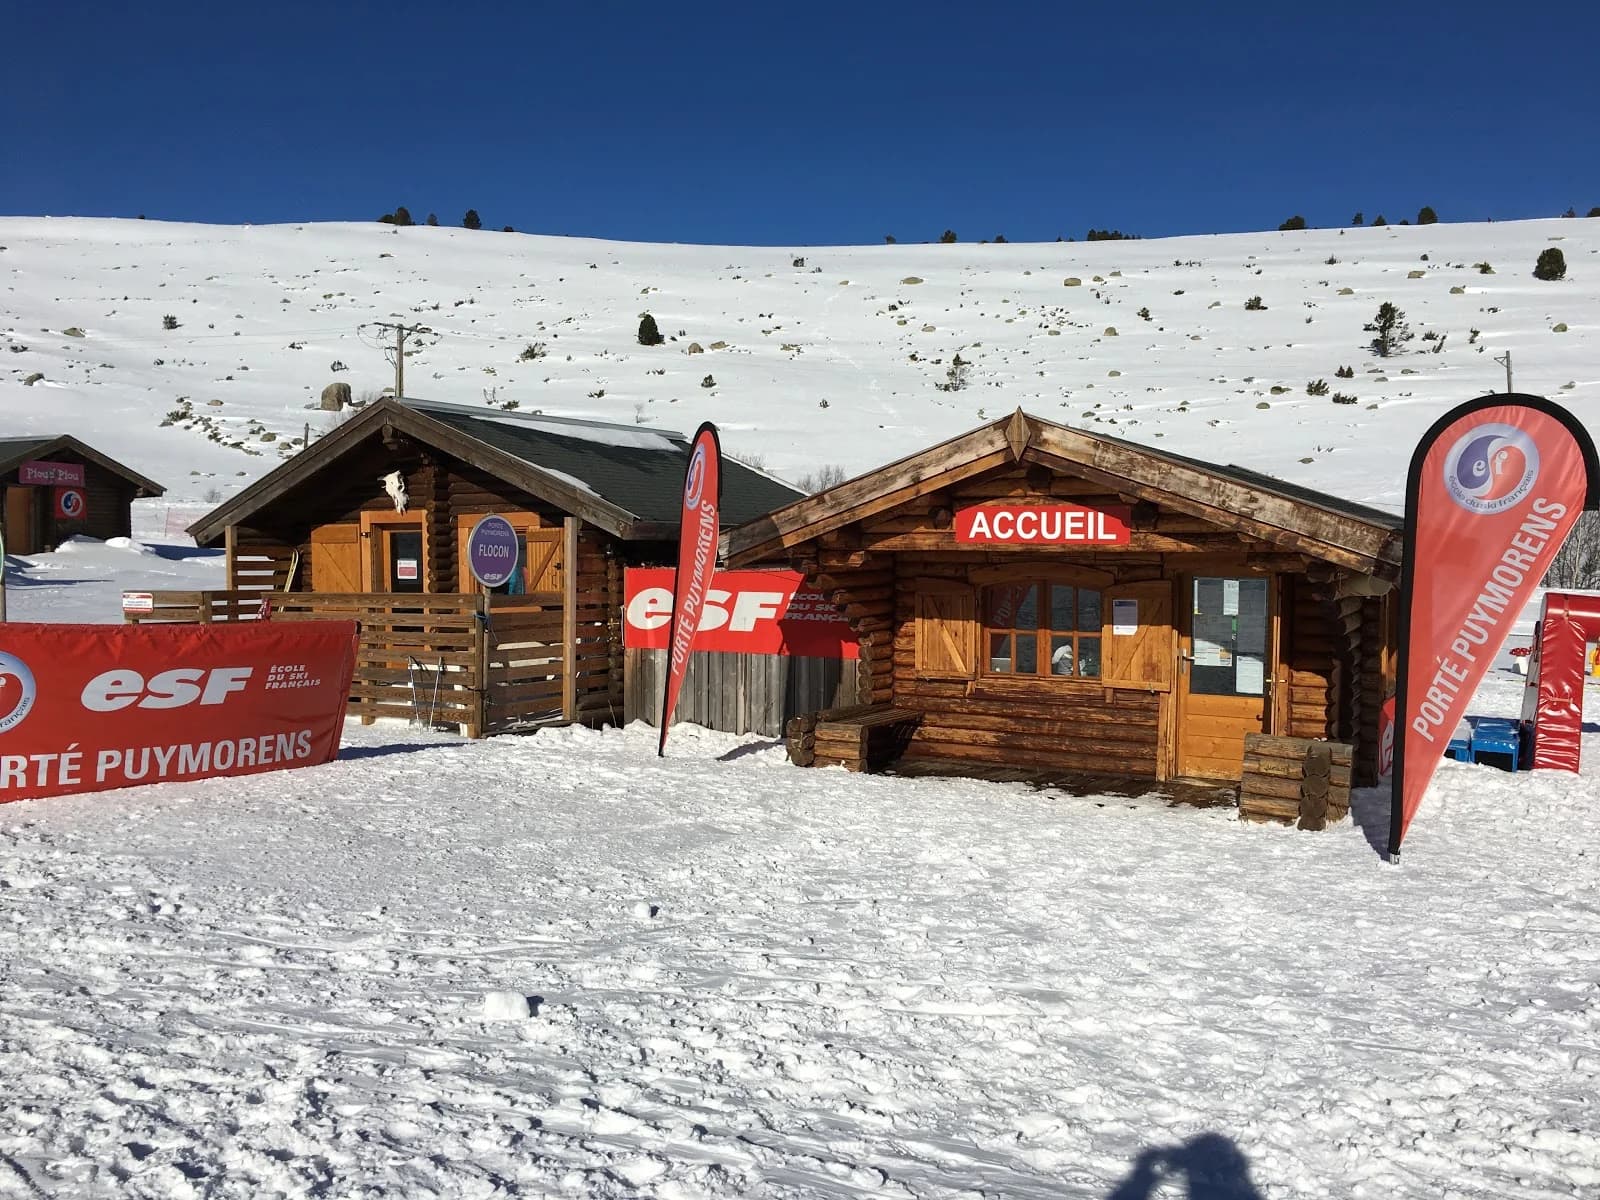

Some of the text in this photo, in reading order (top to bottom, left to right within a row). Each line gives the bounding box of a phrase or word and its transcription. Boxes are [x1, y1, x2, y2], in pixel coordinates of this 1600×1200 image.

[968, 511, 1117, 540] ACCUEIL
[479, 544, 510, 558] FLOCON
[672, 612, 694, 676] PORTÉ
[684, 500, 715, 618] PUYMORENS
[788, 591, 825, 600] ÉCOL
[786, 602, 836, 611] DU SK
[1412, 497, 1567, 743] PORTÉ PUYMORENS
[270, 664, 306, 673] ÉCOLE
[267, 672, 309, 681] DU SKI
[265, 679, 321, 689] FRANÇAIS
[95, 729, 313, 783] PUYMORENS
